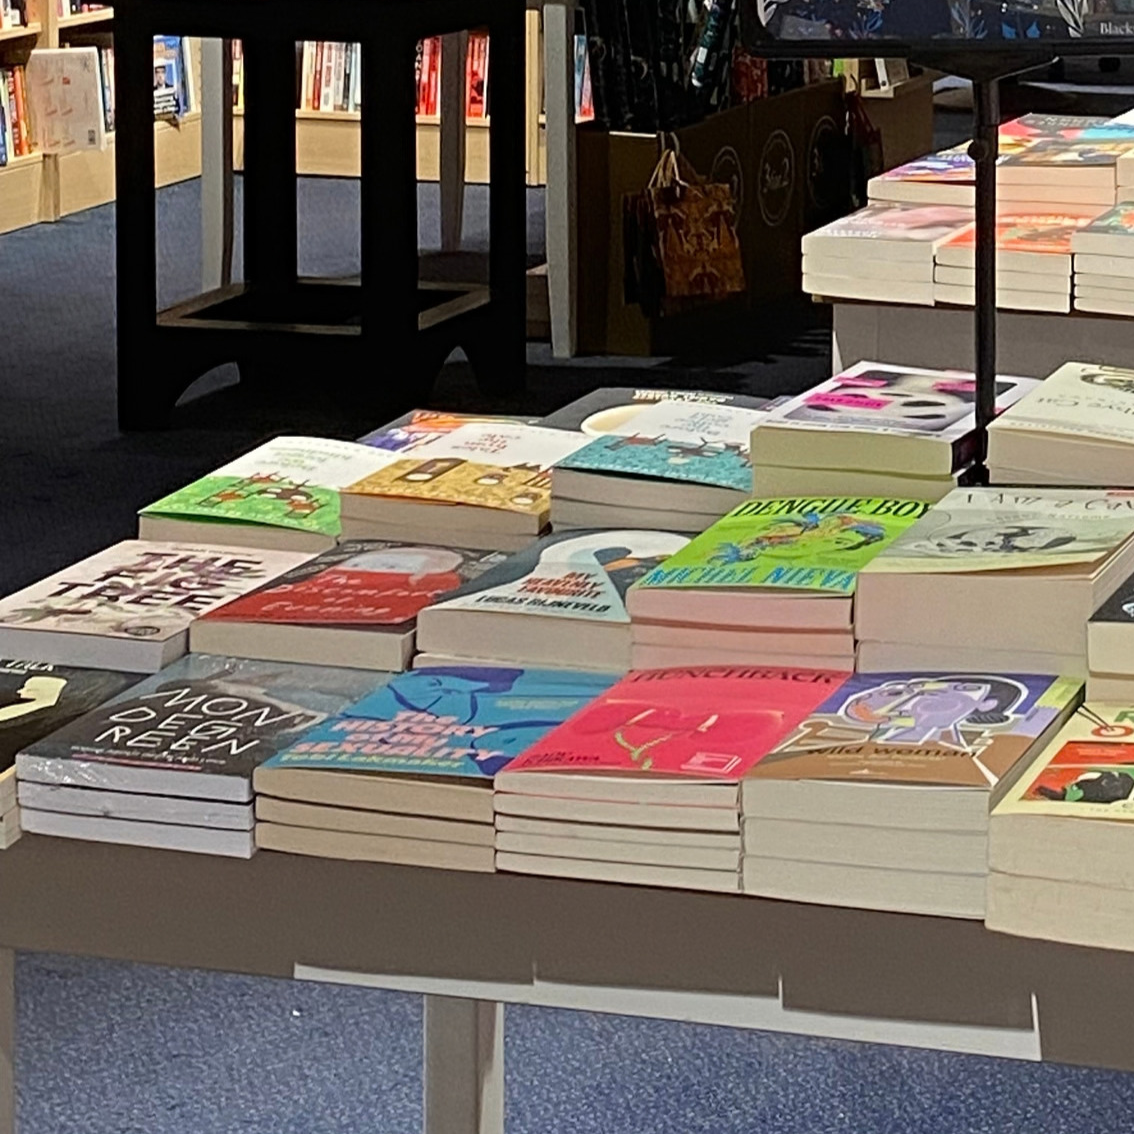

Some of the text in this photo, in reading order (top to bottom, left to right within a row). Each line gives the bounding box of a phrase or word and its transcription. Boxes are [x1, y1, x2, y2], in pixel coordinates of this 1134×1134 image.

[733, 498, 937, 519] DENGUE BOY
[137, 552, 263, 570] THE
[49, 581, 224, 612] TREE
[139, 688, 304, 727] MON
[109, 707, 244, 741] DEG
[331, 718, 500, 738] HISTORY
[94, 726, 261, 756] REEN
